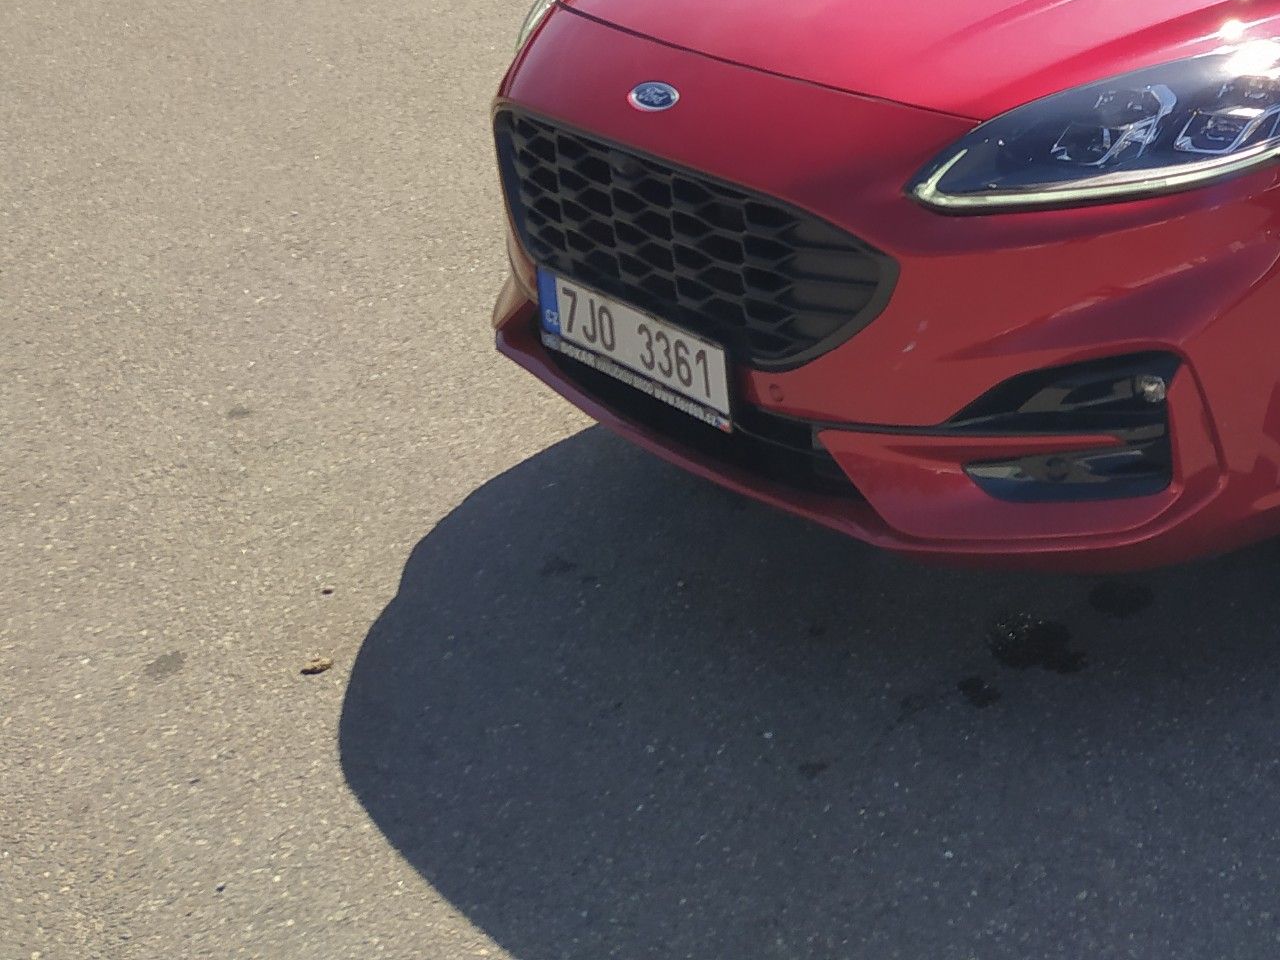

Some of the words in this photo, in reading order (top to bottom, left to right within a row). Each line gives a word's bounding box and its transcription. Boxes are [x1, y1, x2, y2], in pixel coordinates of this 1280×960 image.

[544, 309, 560, 325] CZ
[562, 287, 616, 352] 7J0
[637, 323, 711, 398] 3361
